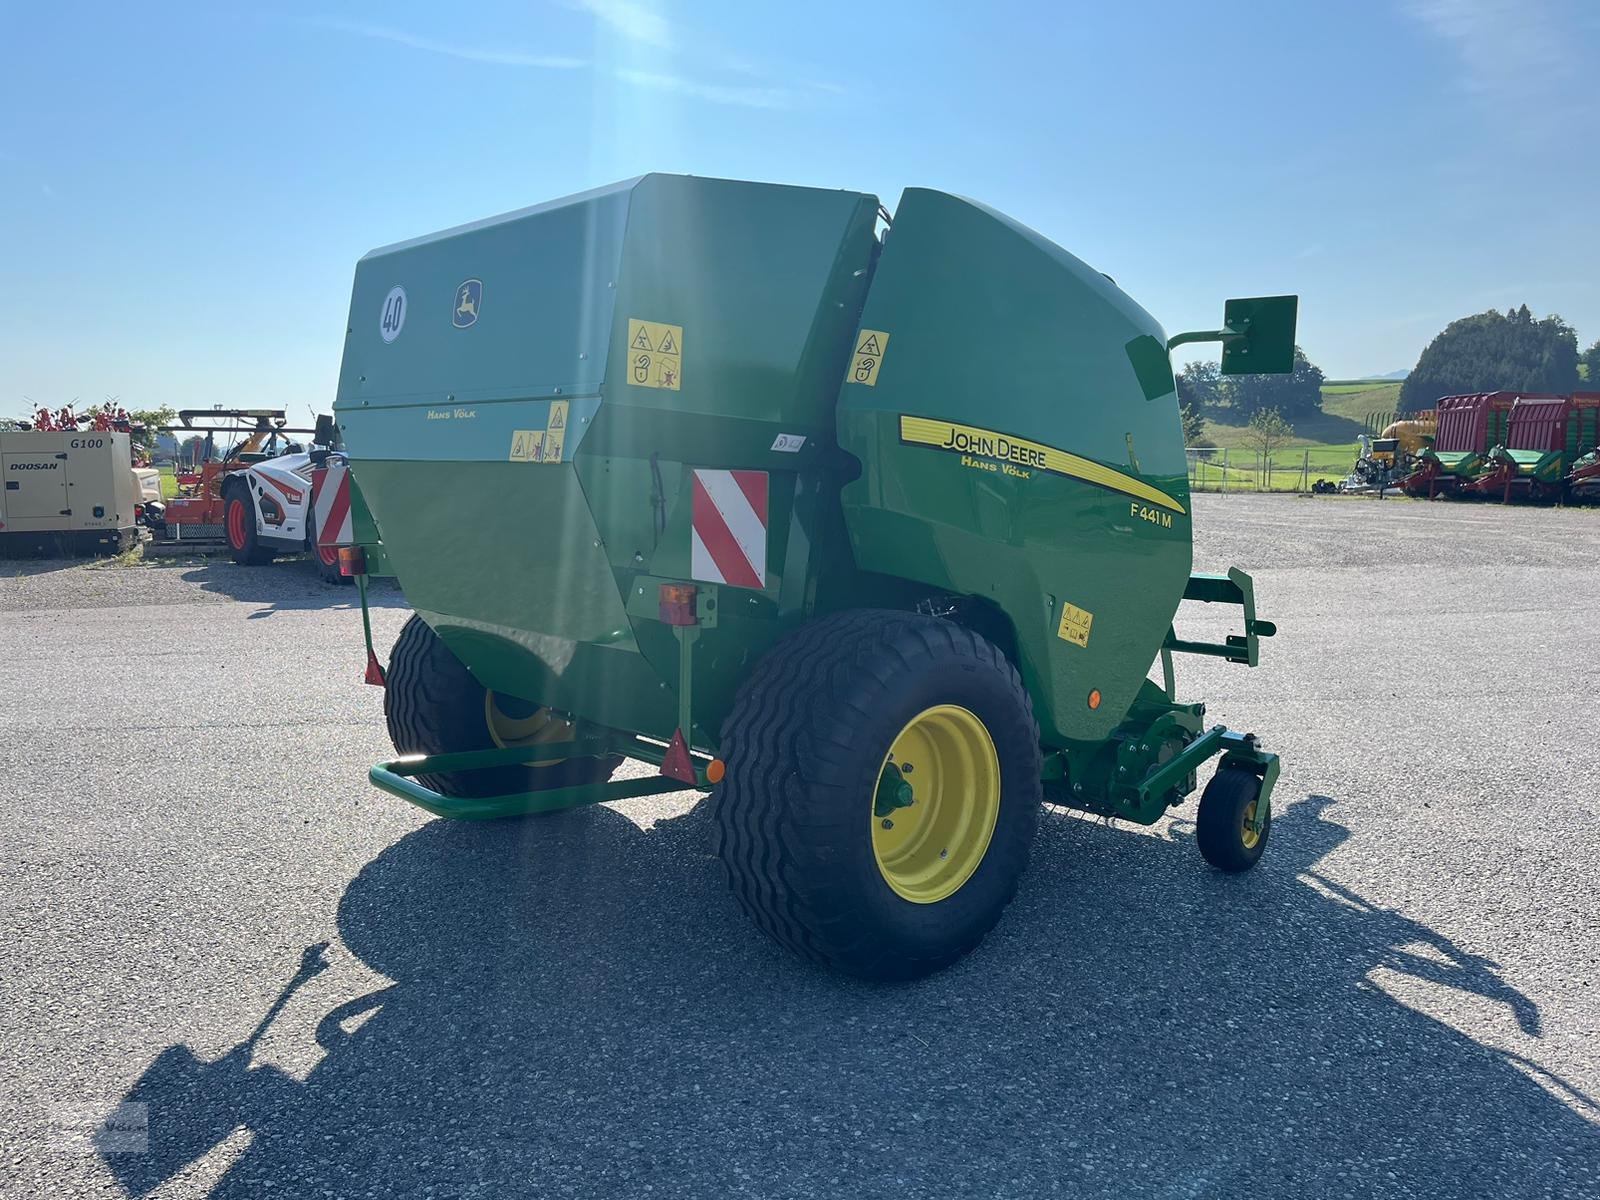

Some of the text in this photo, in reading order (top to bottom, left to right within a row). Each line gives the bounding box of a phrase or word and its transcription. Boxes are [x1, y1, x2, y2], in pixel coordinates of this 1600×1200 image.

[383, 296, 402, 332] 40
[427, 408, 476, 420] HANS VÖLK
[70, 439, 103, 449] G100
[942, 428, 1047, 467] JOHN DEERE
[10, 463, 58, 471] DOOSAN
[961, 455, 1030, 479] HANS VÖLK
[1130, 502, 1172, 529] F 441 M
